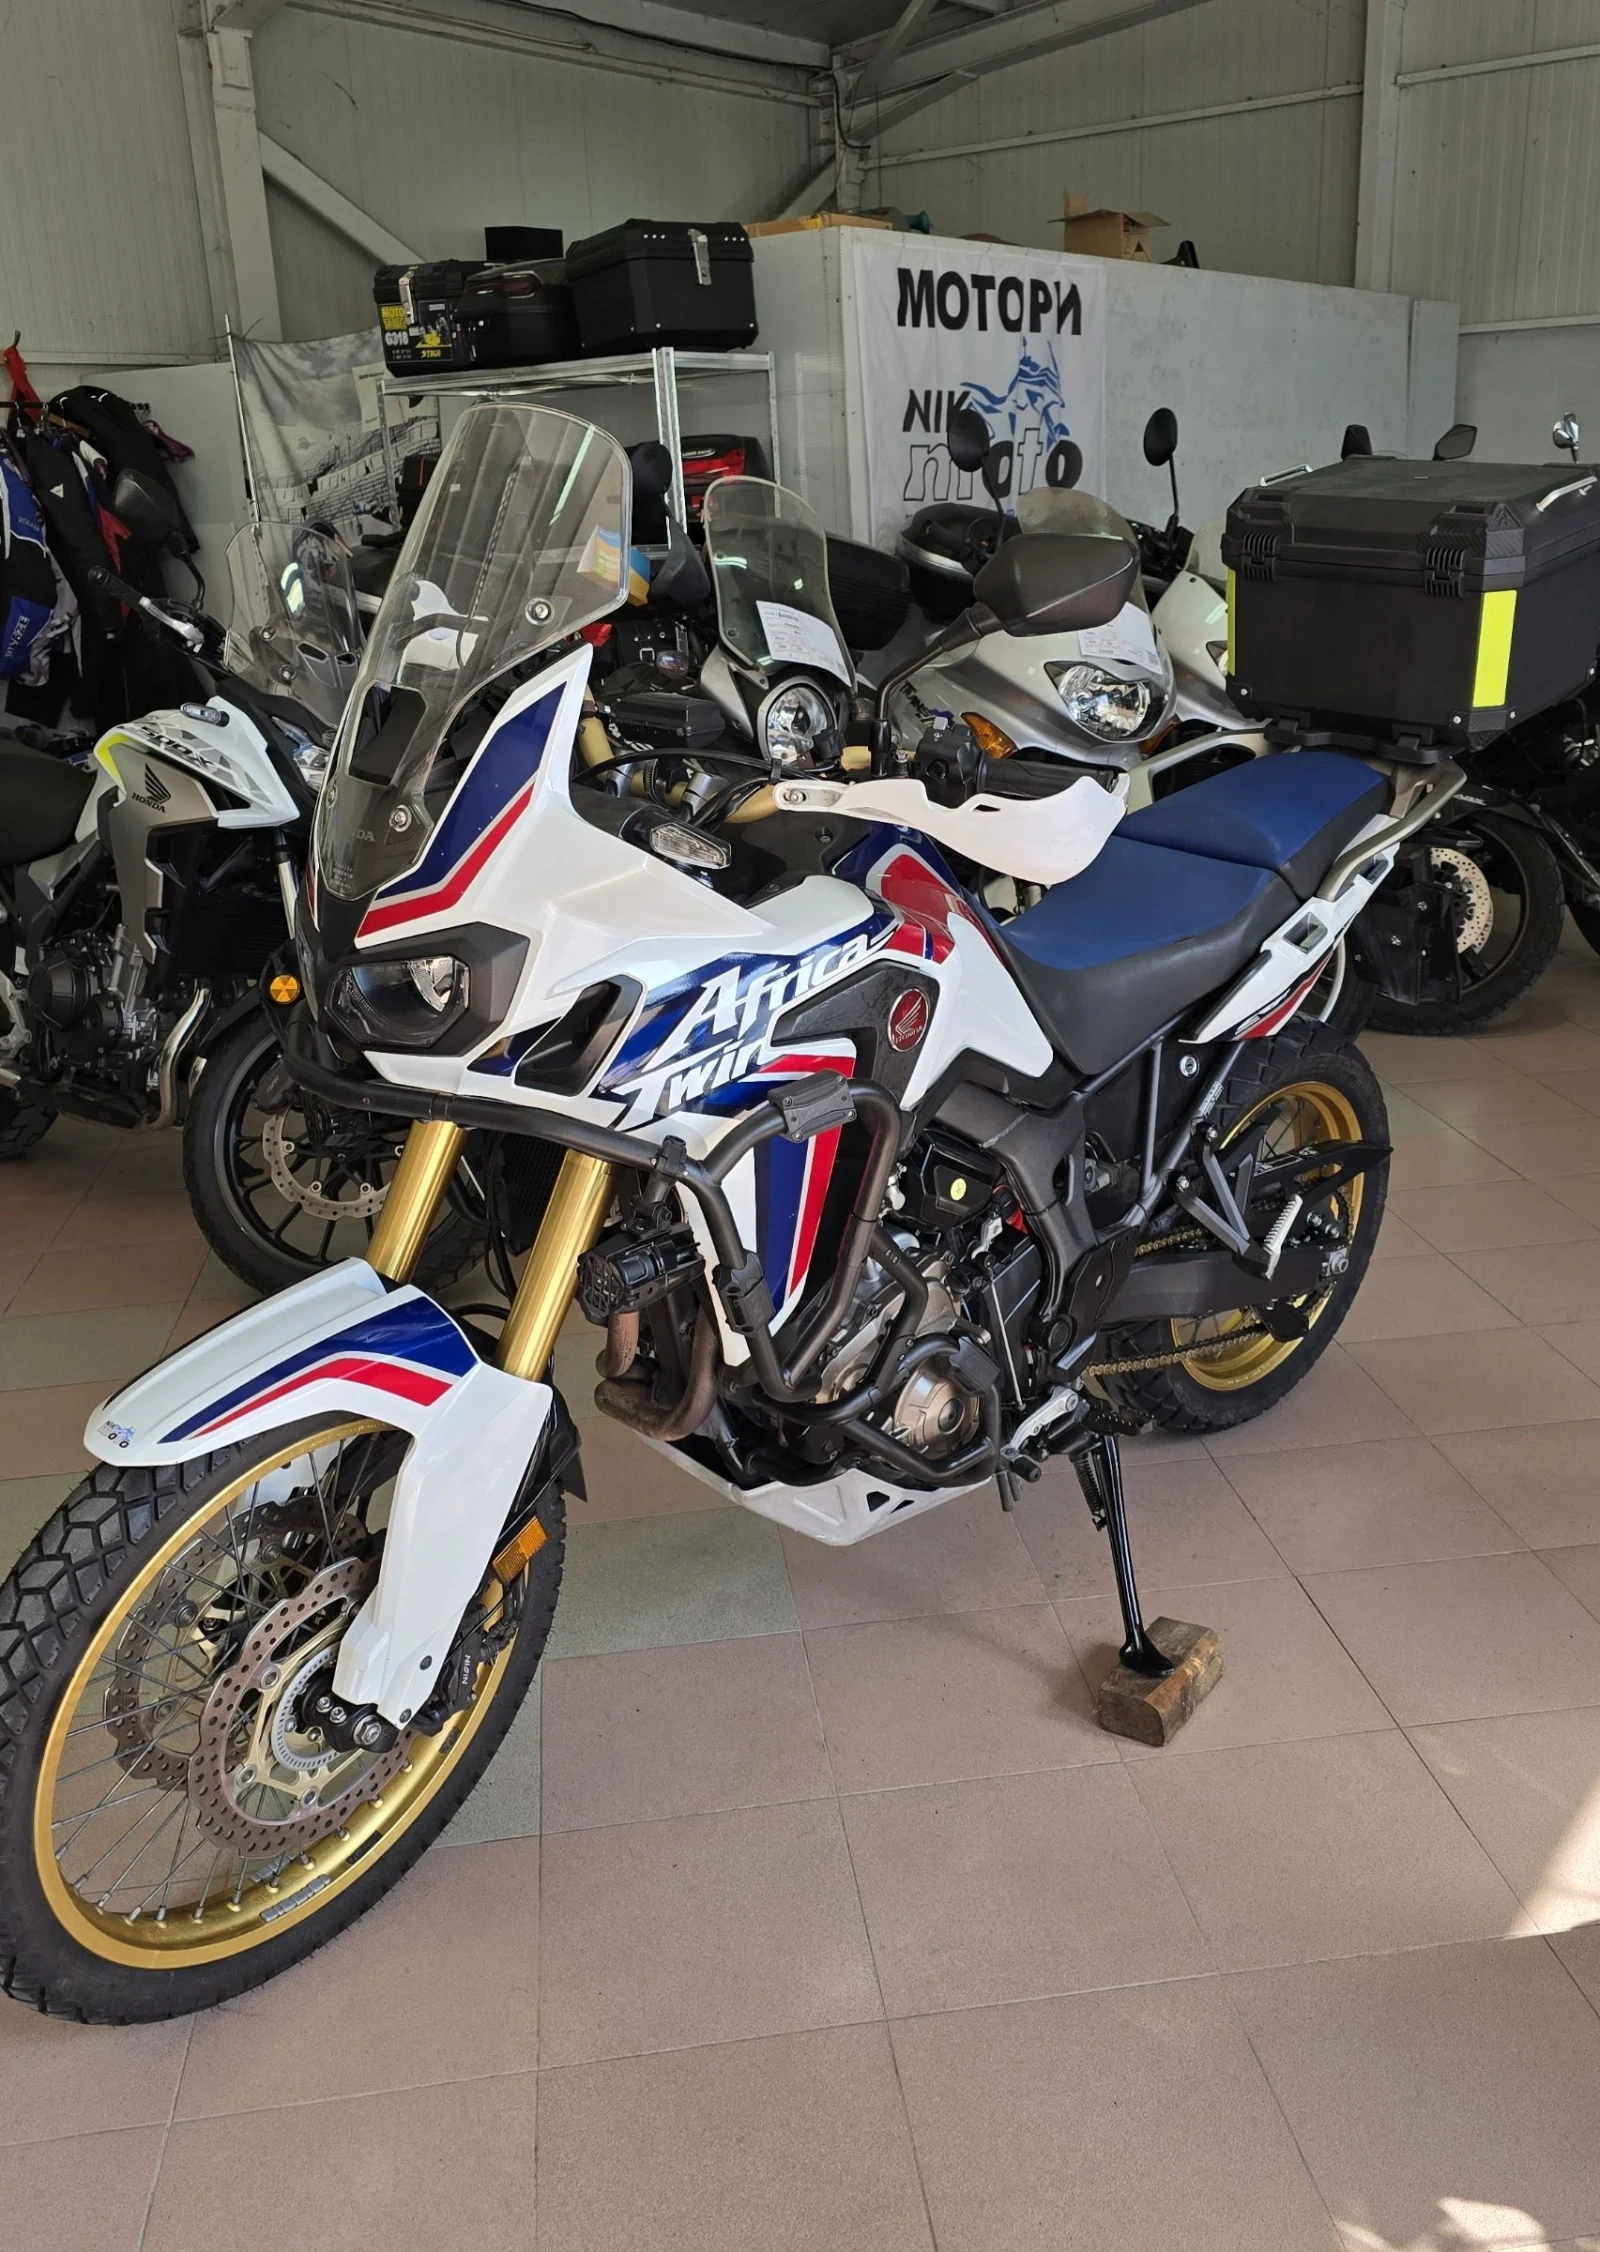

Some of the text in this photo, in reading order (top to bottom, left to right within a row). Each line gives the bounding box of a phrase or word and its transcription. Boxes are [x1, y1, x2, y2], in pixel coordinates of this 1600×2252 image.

[897, 267, 1082, 335] МОТОРИ
[385, 331, 409, 346] G318
[132, 792, 166, 813] HONDA
[642, 924, 898, 1073] Africa
[611, 1035, 768, 1131] Twin
